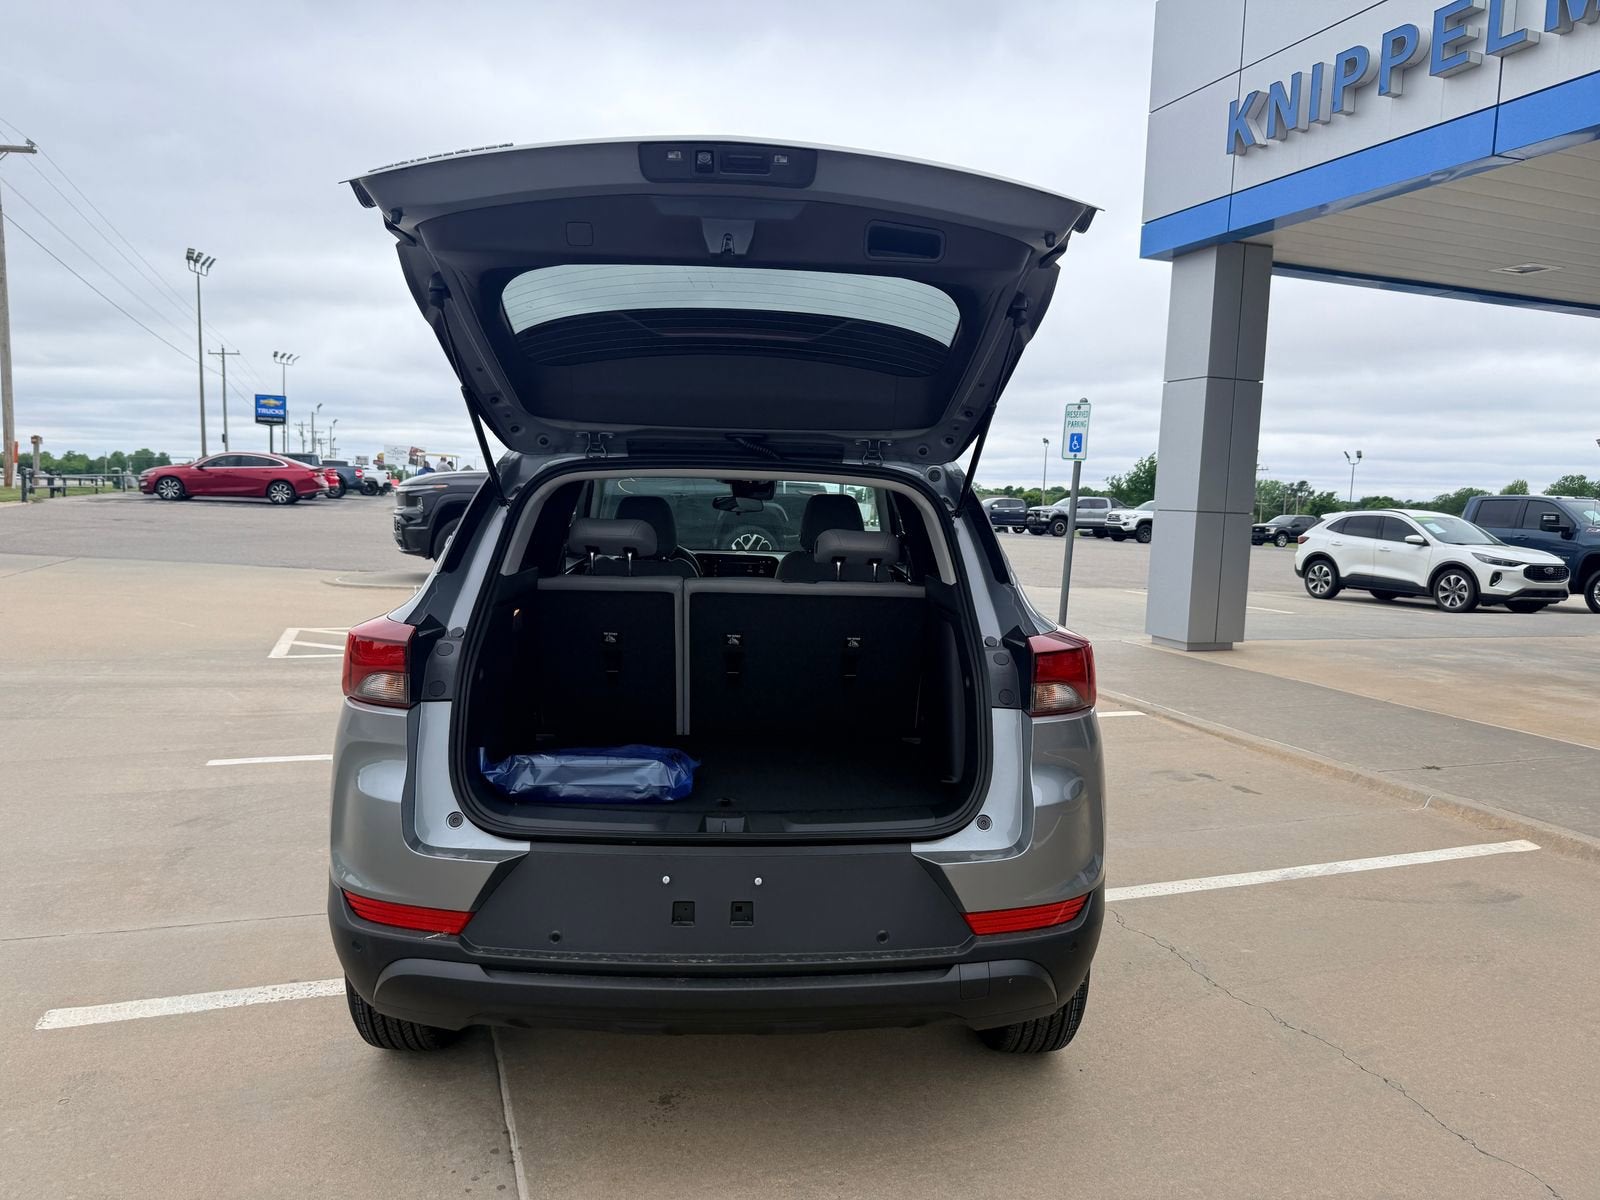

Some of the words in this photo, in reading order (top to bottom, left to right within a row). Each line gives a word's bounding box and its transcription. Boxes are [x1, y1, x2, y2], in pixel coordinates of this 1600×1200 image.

[257, 407, 285, 415] TRUCKS
[1066, 410, 1089, 419] RESERVED
[1067, 420, 1087, 428] PARKING
